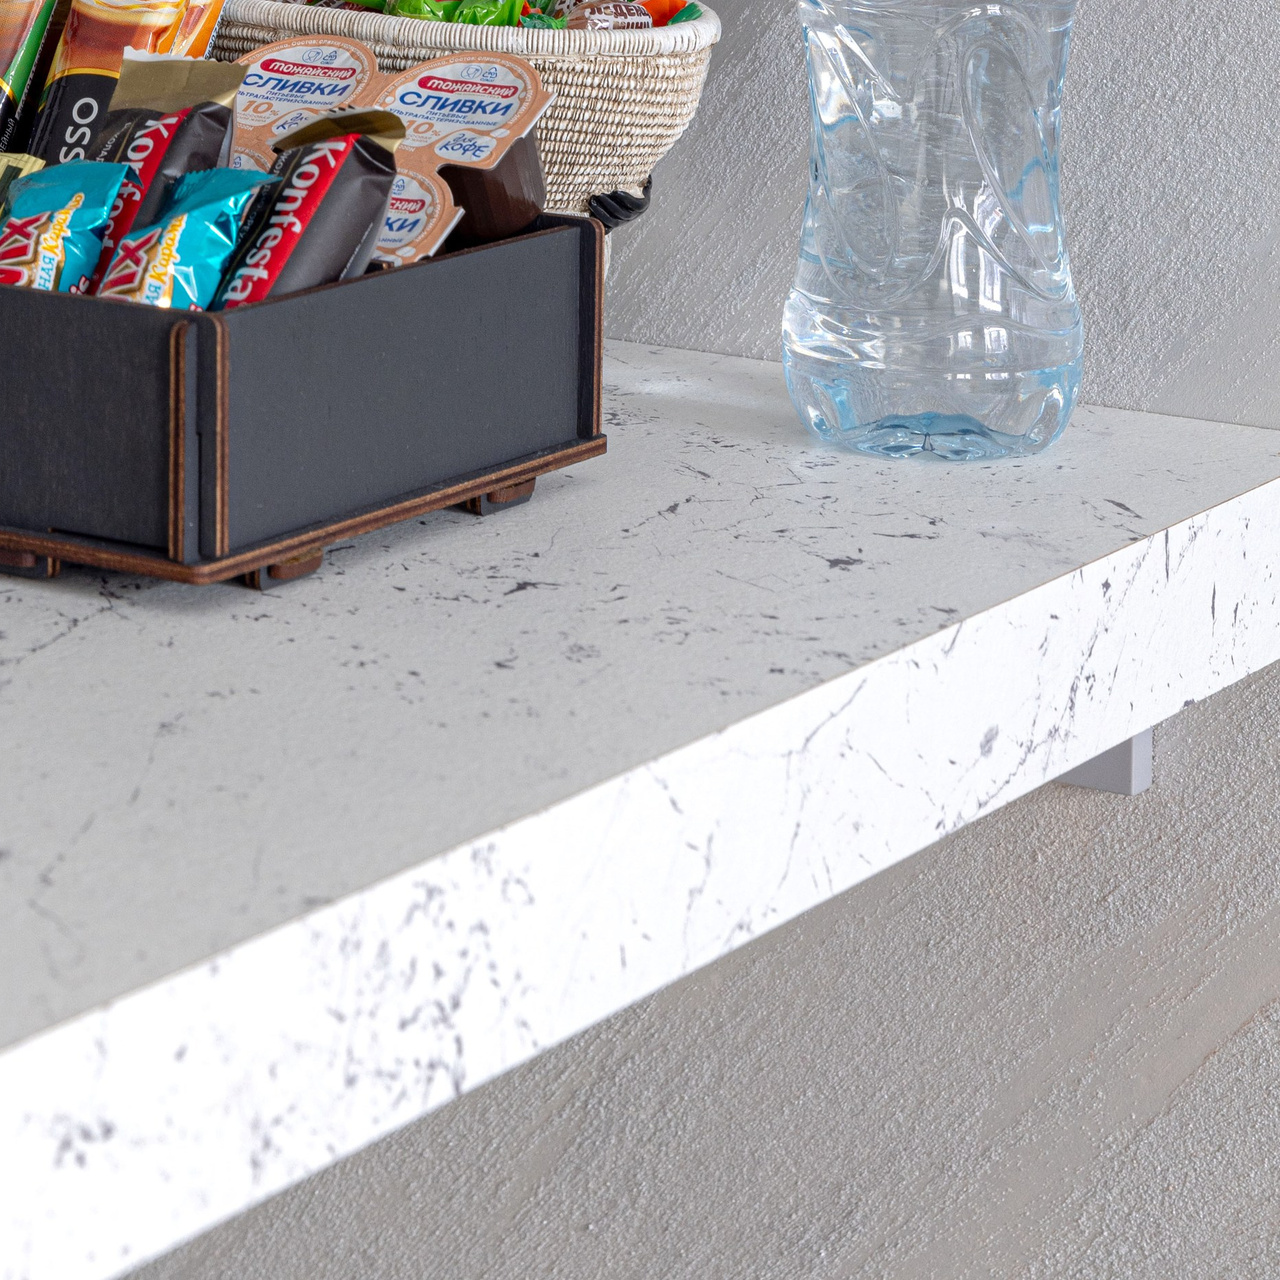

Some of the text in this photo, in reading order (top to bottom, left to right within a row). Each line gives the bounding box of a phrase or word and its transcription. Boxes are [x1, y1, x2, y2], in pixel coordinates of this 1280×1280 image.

[589, 4, 652, 20] ЛЕДЕНЦ
[269, 61, 353, 79] МОЖАЙСКИЙ
[242, 73, 352, 97] СЛИВКИ
[427, 79, 515, 97] МОЖАЙСКИЙ
[237, 90, 335, 106] ЬТРАПАСТЕРИЗОВАННЫЕ
[266, 90, 307, 100] ПИТЬЕВЫЕ
[399, 91, 514, 117] СЛИВКИ
[425, 110, 469, 120] ПИТЬЕВЫЕ
[439, 141, 490, 158] КОФЕ
[222, 141, 347, 302] Konfesta
